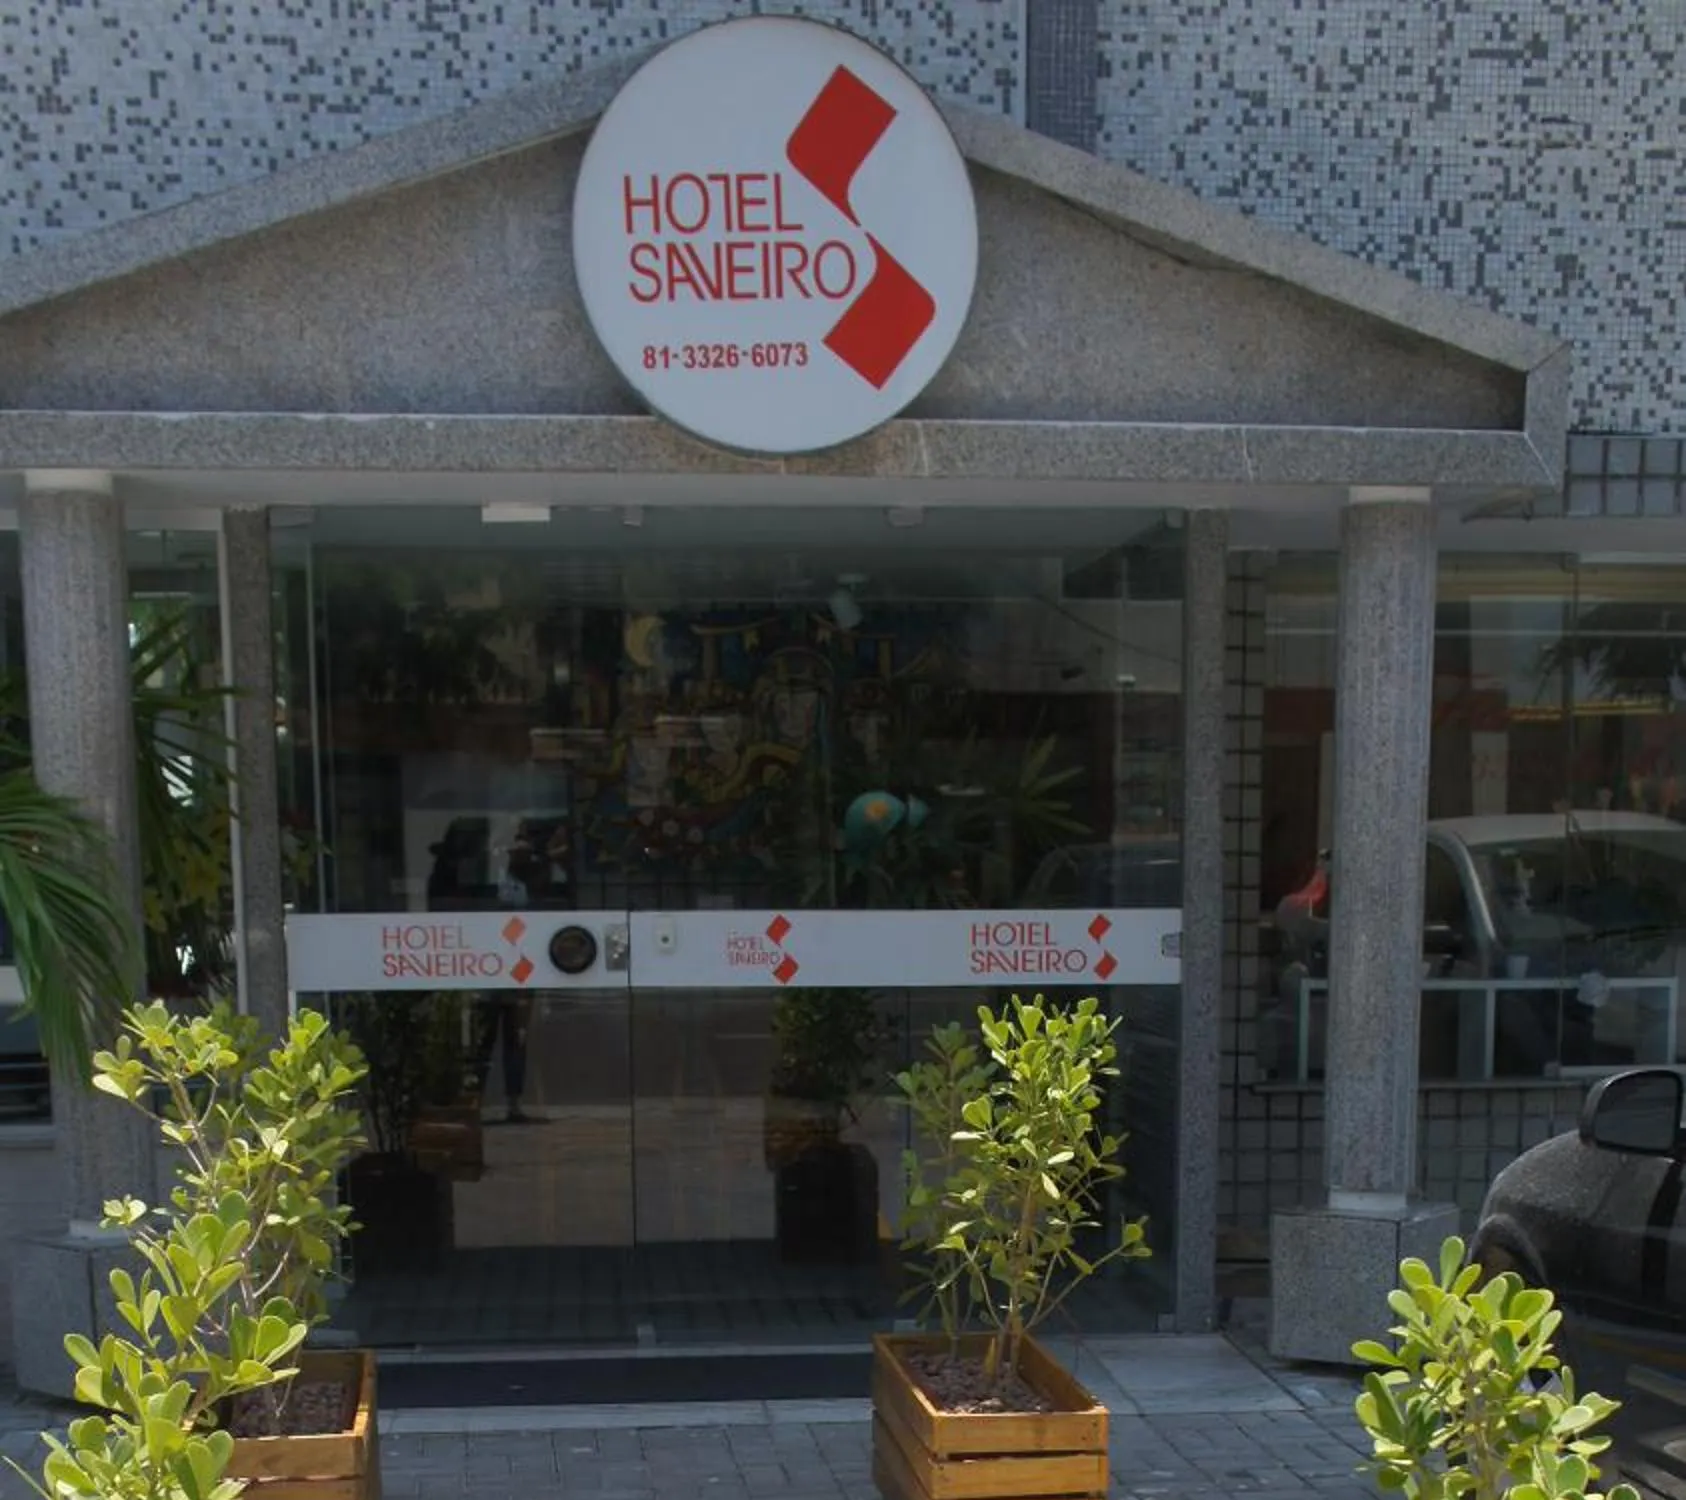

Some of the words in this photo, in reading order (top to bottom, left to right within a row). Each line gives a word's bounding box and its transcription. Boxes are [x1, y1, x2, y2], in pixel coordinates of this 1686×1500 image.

[624, 173, 804, 234] HOTEL
[629, 241, 857, 303] SAVEIRO
[643, 342, 809, 370] 81-3326-6073
[382, 925, 470, 951] HOTEL
[971, 921, 1057, 946] HOTEL
[382, 952, 503, 978] SAVEIRO
[970, 949, 1088, 974] SAVEIRO
